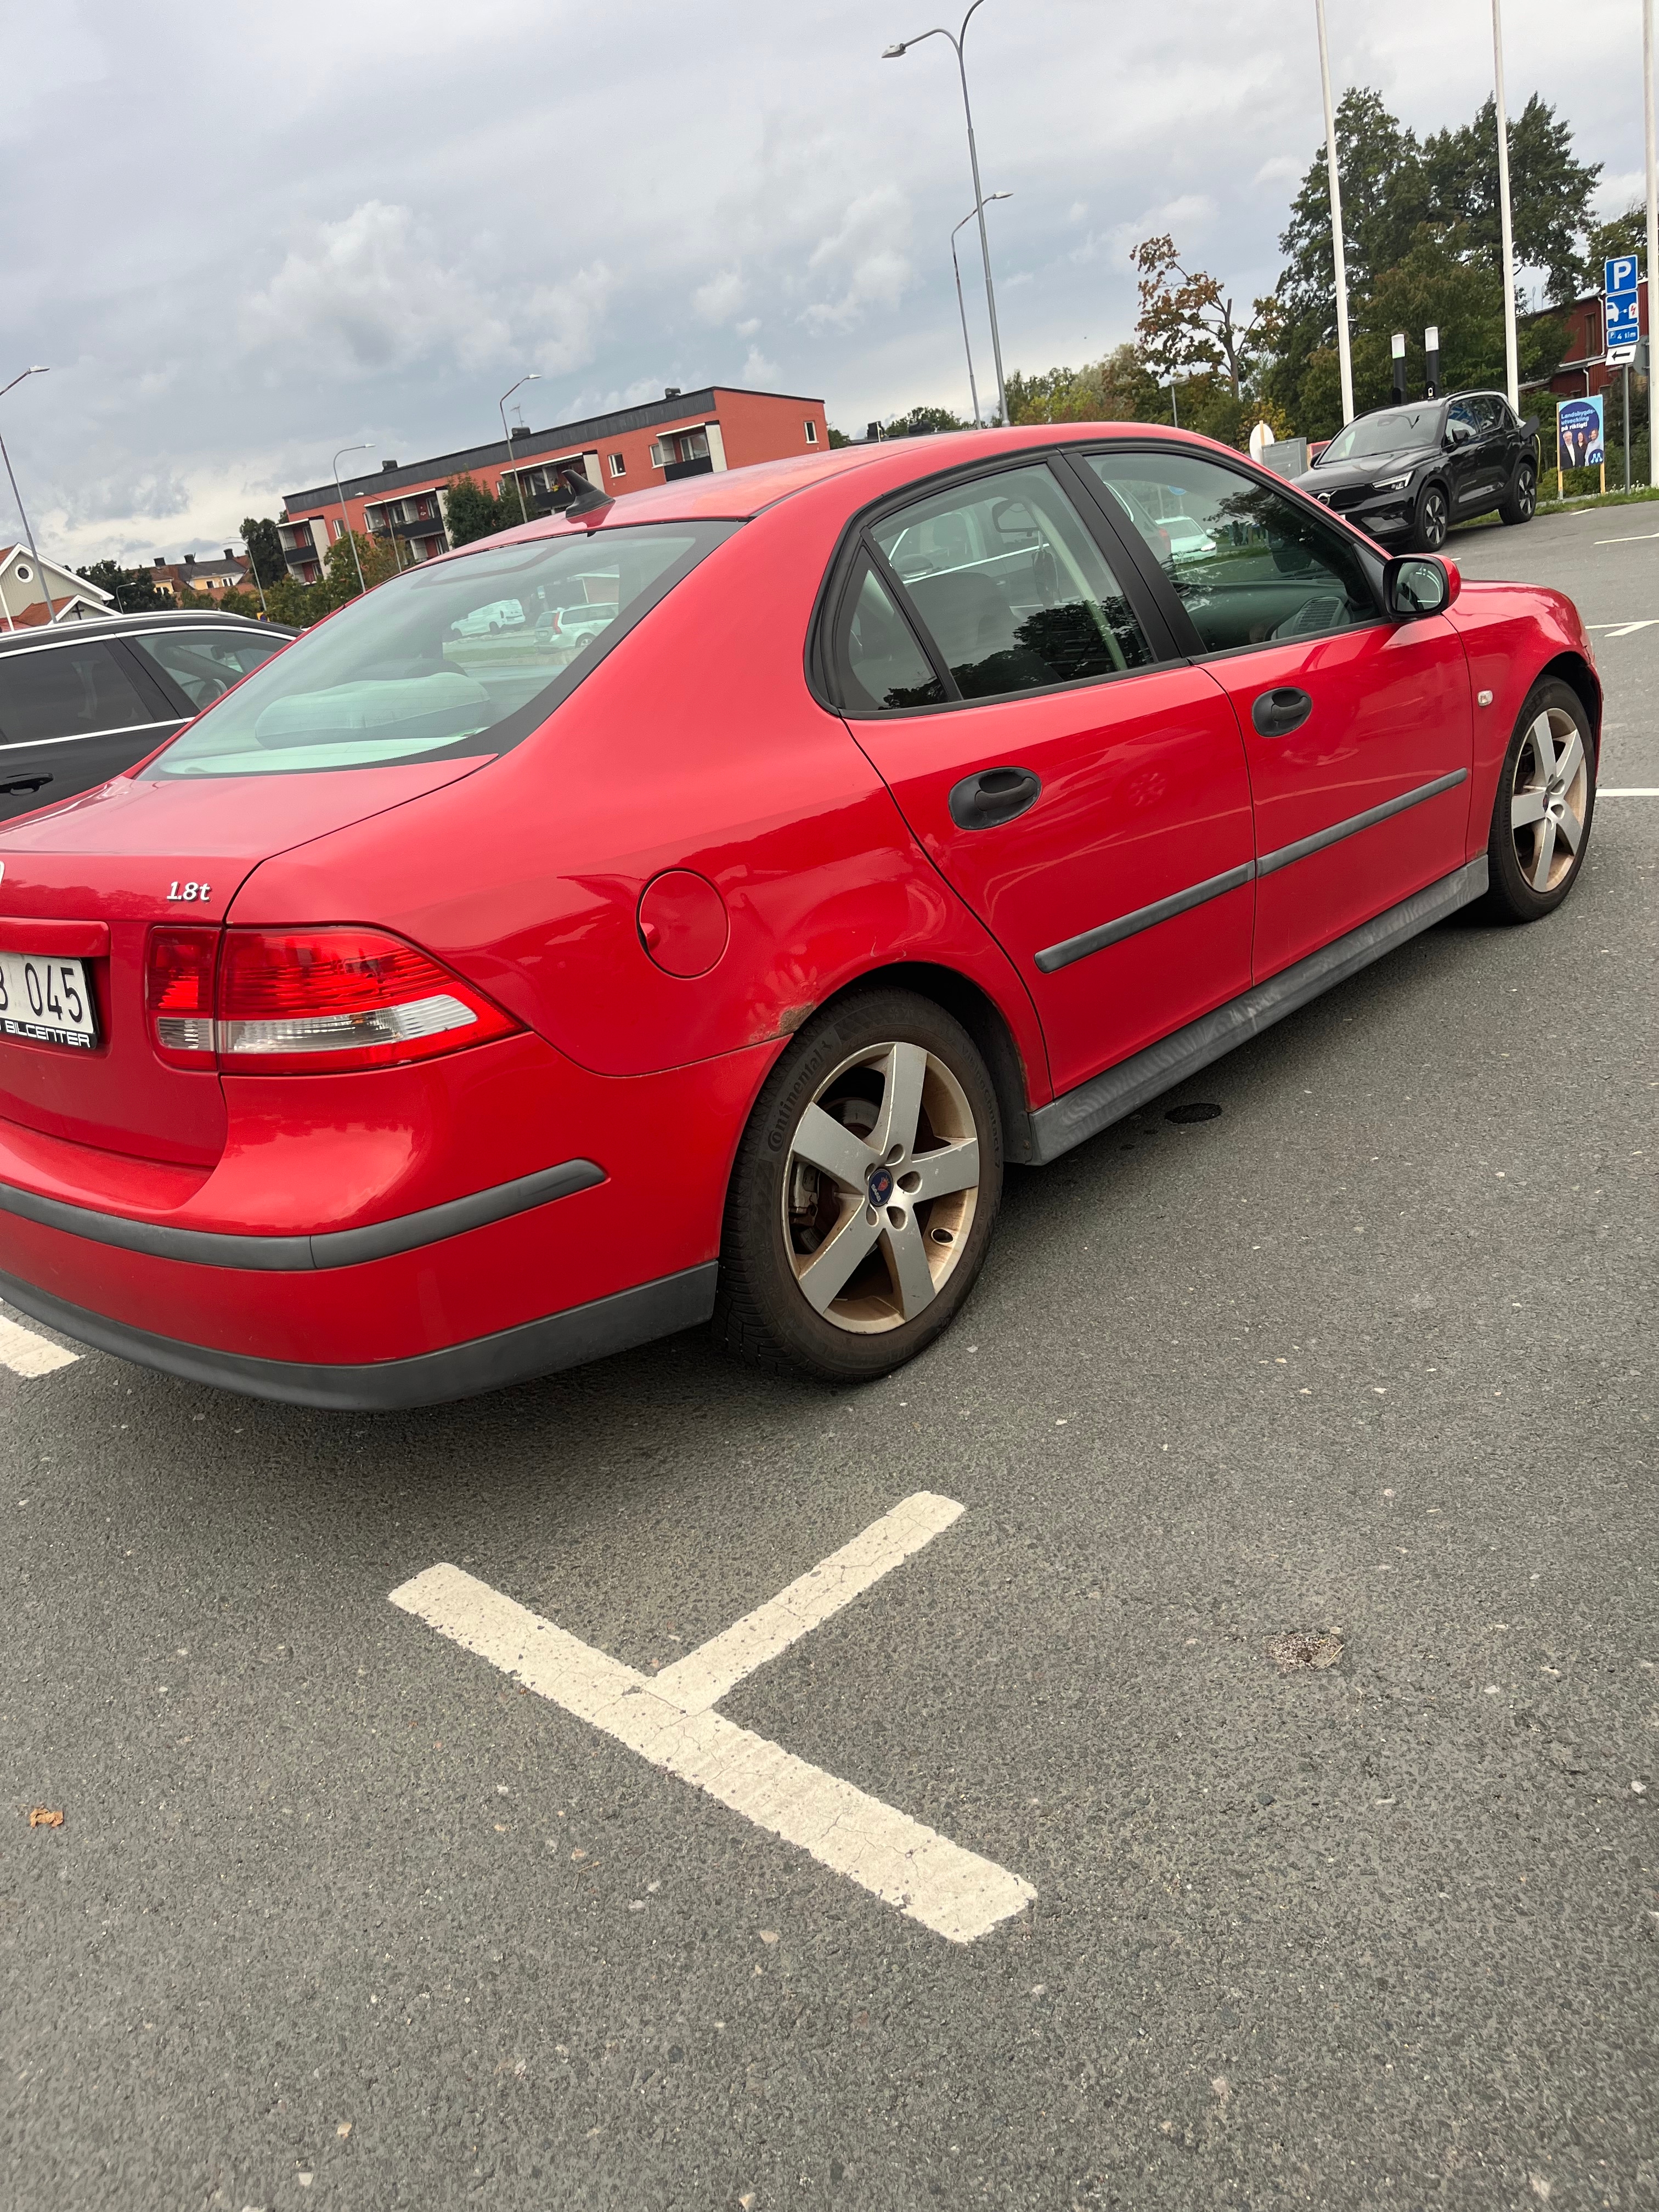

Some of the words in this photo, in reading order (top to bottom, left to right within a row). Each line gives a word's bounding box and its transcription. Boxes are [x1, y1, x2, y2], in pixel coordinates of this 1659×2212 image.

[1613, 261, 1632, 290] P
[1561, 408, 1595, 419] Landsbygds-
[1561, 416, 1589, 425] utveckling
[1569, 421, 1588, 429] riktigt!
[166, 881, 211, 901] 1.8t
[25, 962, 83, 1023] 045
[4, 1019, 91, 1048] BILCENTER
[768, 1048, 825, 1152] Continental
[871, 1183, 882, 1202] SAAB
